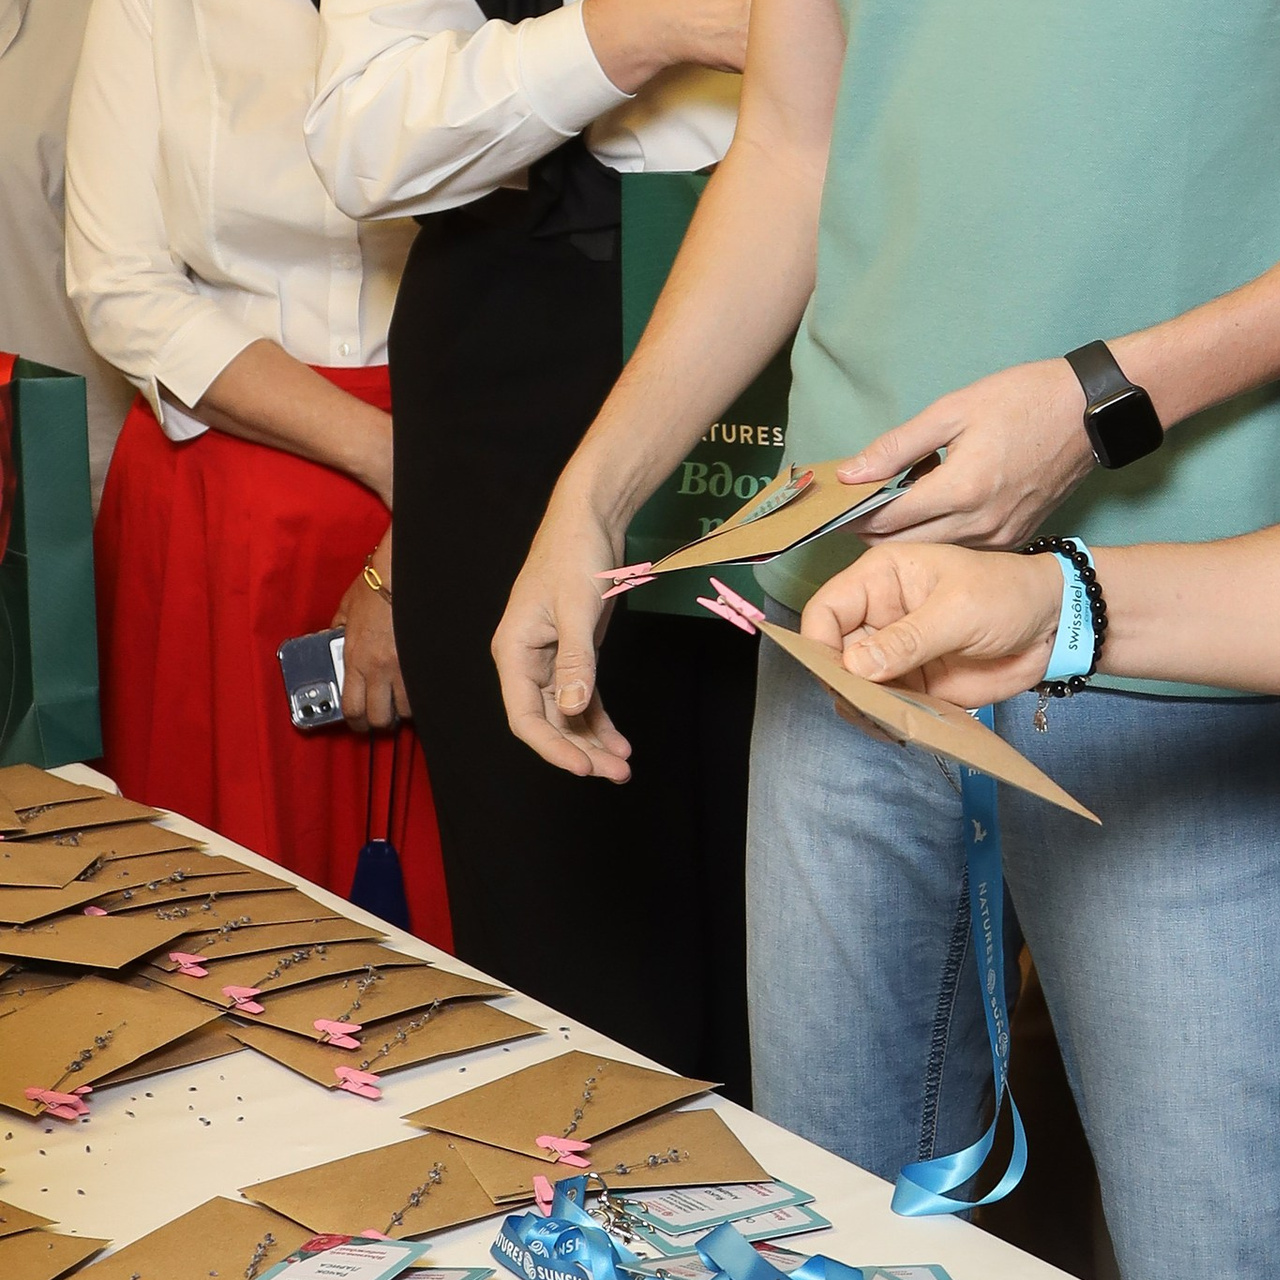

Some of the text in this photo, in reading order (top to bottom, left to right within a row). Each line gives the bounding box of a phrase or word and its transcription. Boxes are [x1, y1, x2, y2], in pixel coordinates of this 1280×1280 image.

[702, 423, 784, 446] TURES
[677, 462, 773, 499] Вдо
[1069, 585, 1082, 650] swissôtel
